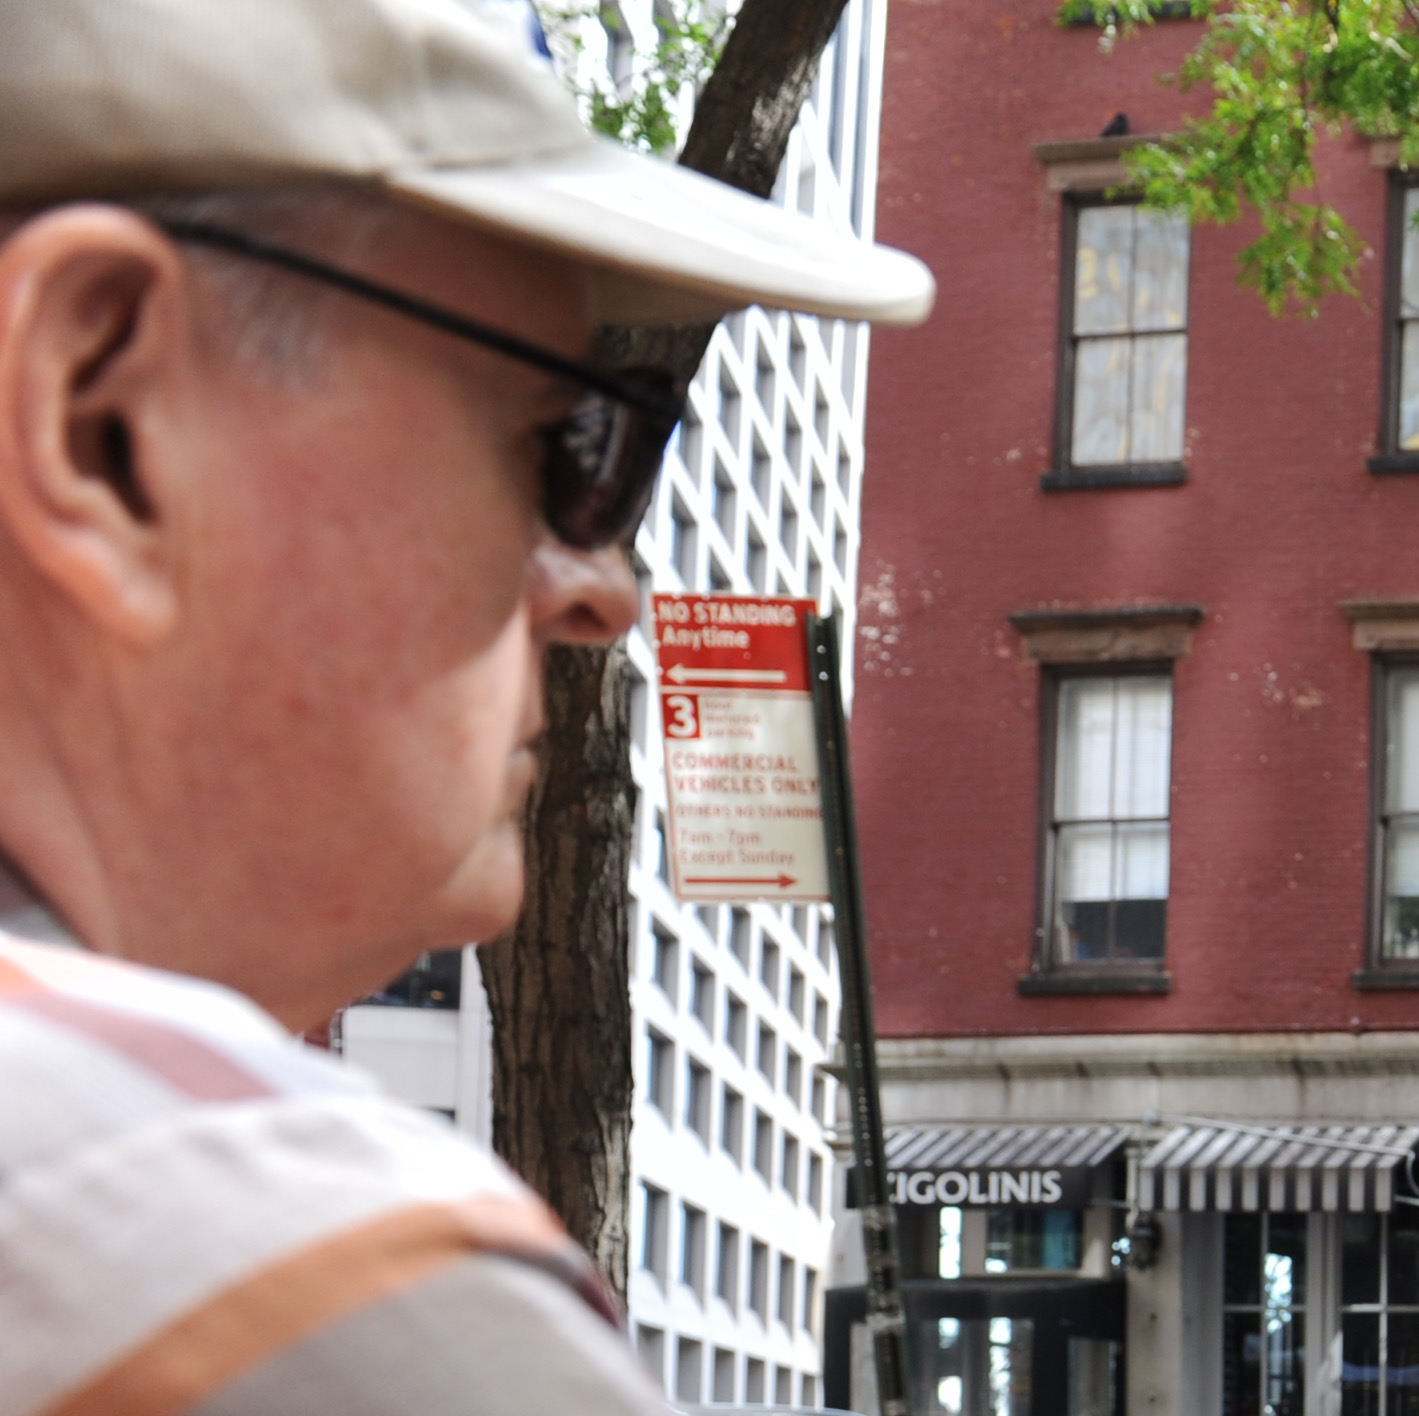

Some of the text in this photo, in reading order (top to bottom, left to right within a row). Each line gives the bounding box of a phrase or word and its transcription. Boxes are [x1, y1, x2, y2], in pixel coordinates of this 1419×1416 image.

[658, 601, 796, 627] NO STANDING
[662, 624, 750, 650] Anytime
[667, 695, 697, 737] 3
[672, 752, 797, 773] COMMERCIAL
[675, 776, 820, 795] VEHICLES ONLY
[741, 850, 794, 866] Sunday
